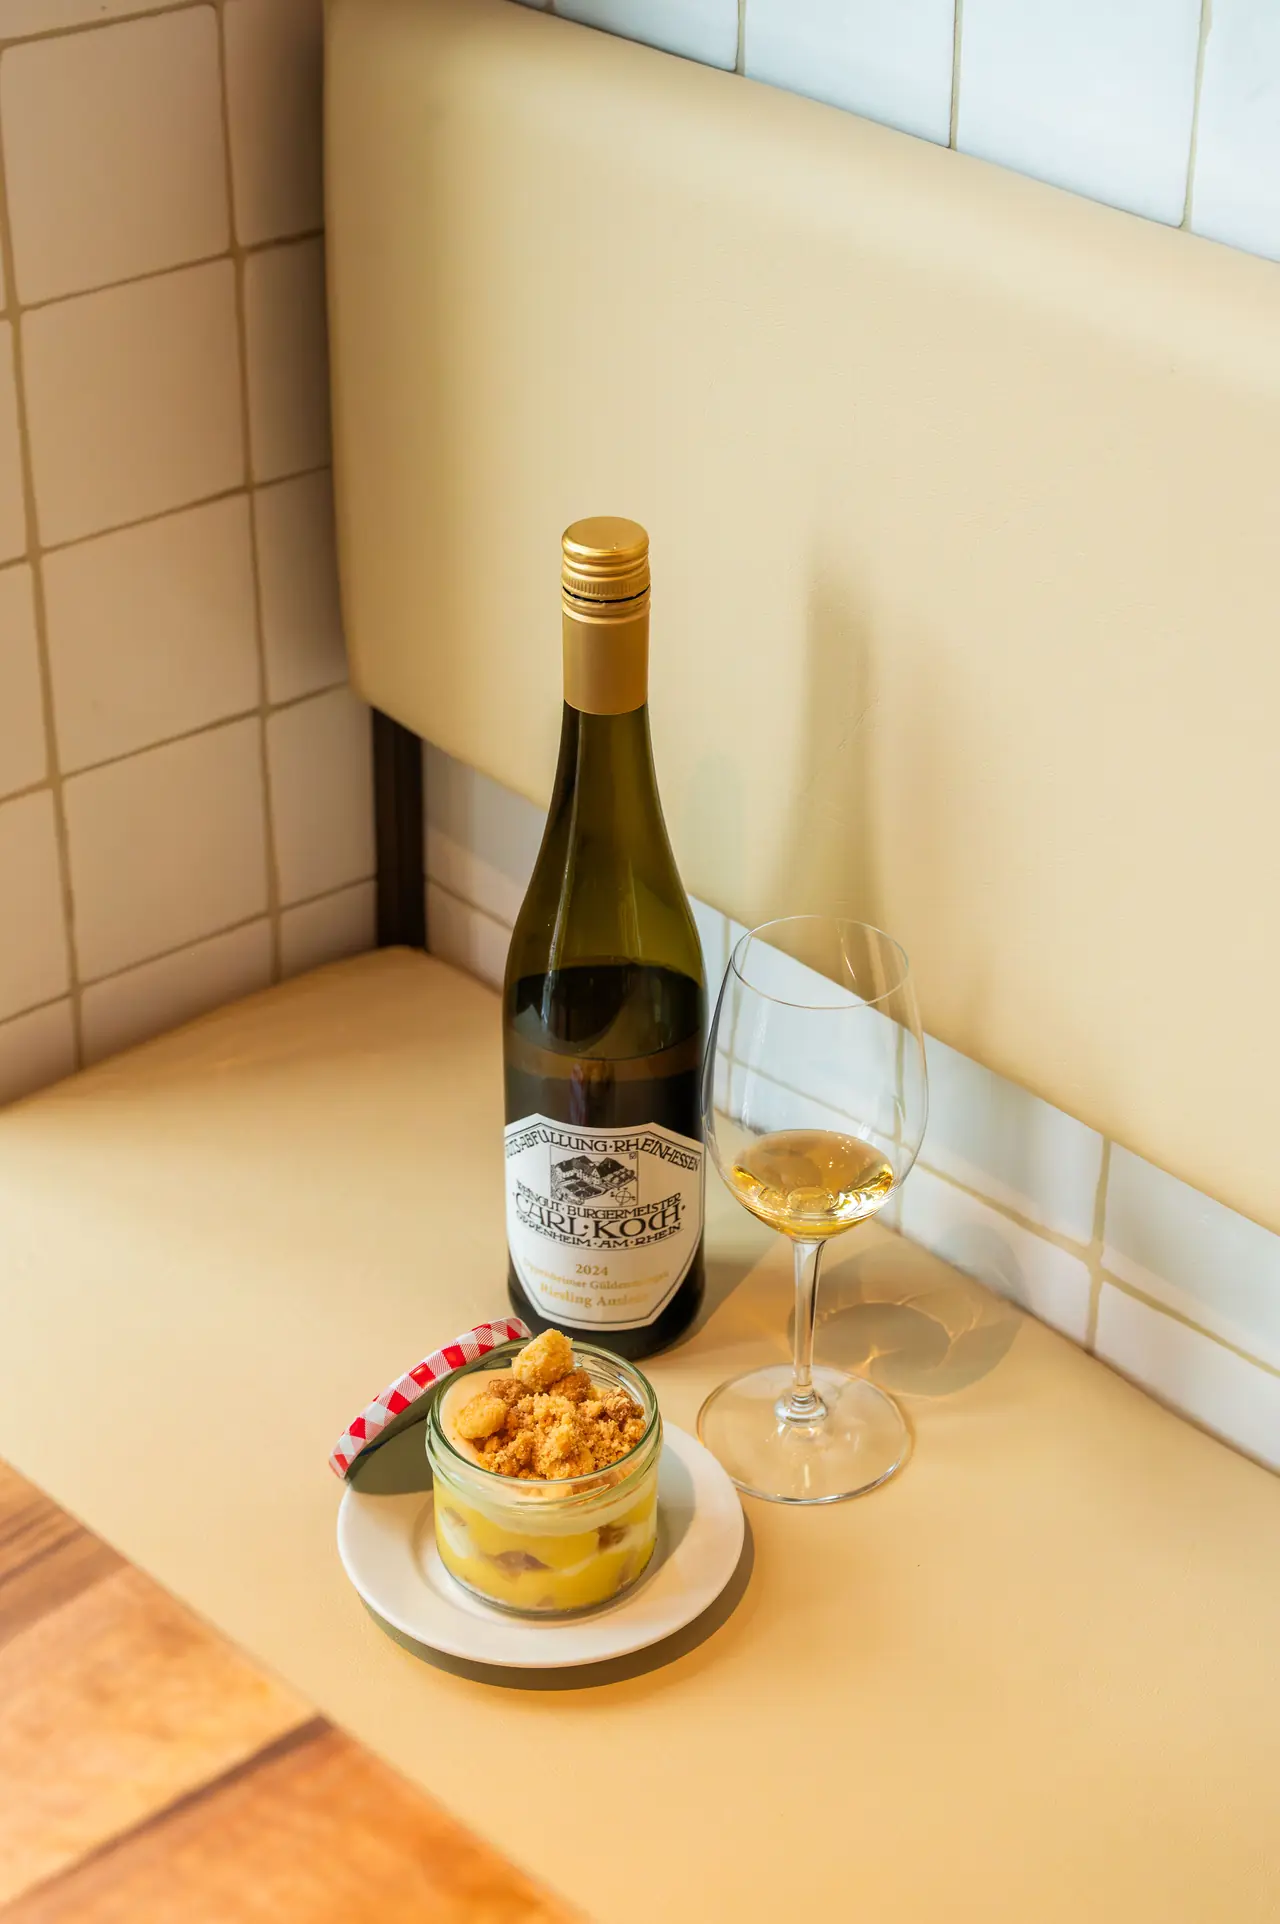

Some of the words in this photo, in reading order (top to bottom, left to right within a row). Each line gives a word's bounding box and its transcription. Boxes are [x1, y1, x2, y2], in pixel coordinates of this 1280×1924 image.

[613, 1138, 700, 1171] RHEINHESSEN
[515, 1192, 586, 1237] CARL
[593, 1204, 680, 1239] KOCH
[599, 1239, 629, 1248] AM
[635, 1222, 681, 1245] RHEIN
[575, 1263, 609, 1276] 2024
[540, 1282, 592, 1308] Riesling
